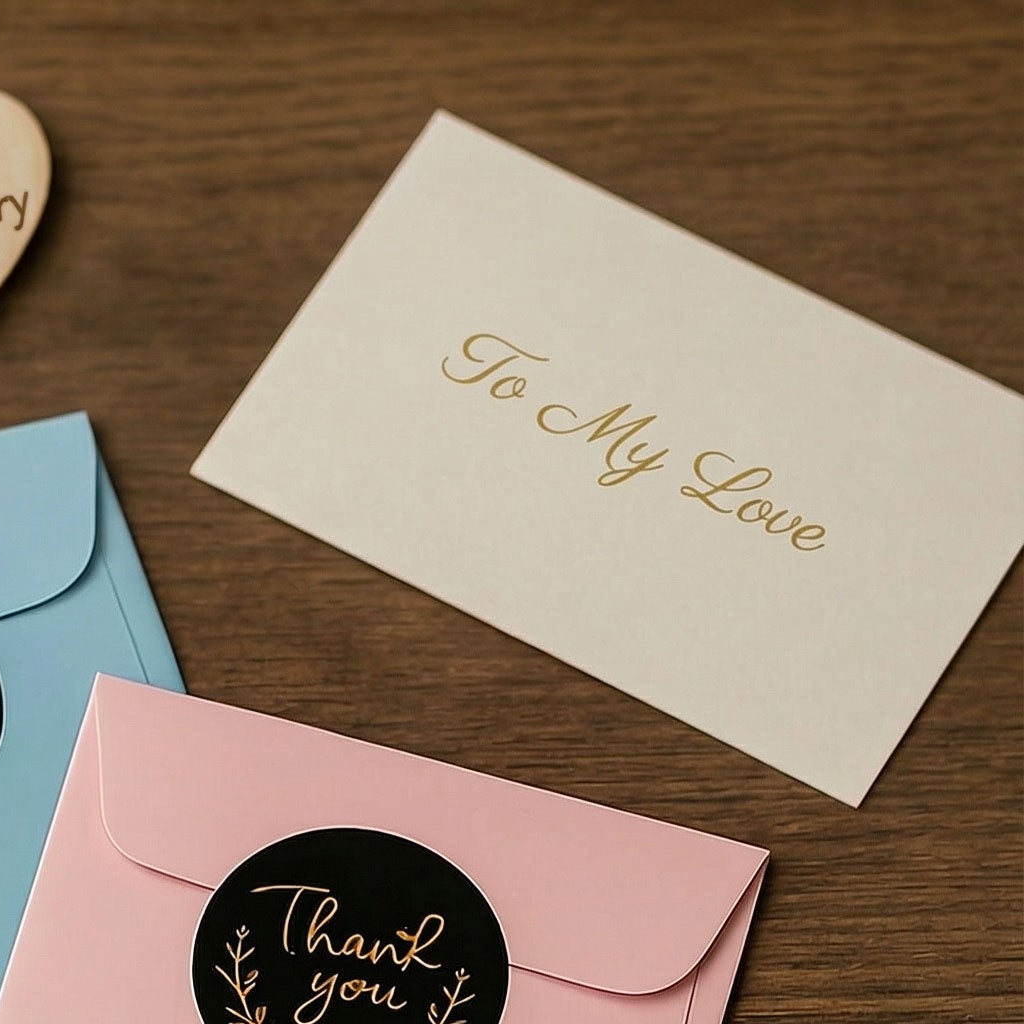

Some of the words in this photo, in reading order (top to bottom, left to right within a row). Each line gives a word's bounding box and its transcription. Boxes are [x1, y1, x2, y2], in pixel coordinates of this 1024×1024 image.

[441, 333, 551, 399] To
[536, 403, 669, 487] My
[680, 451, 826, 551] Love
[250, 885, 445, 971] Thank
